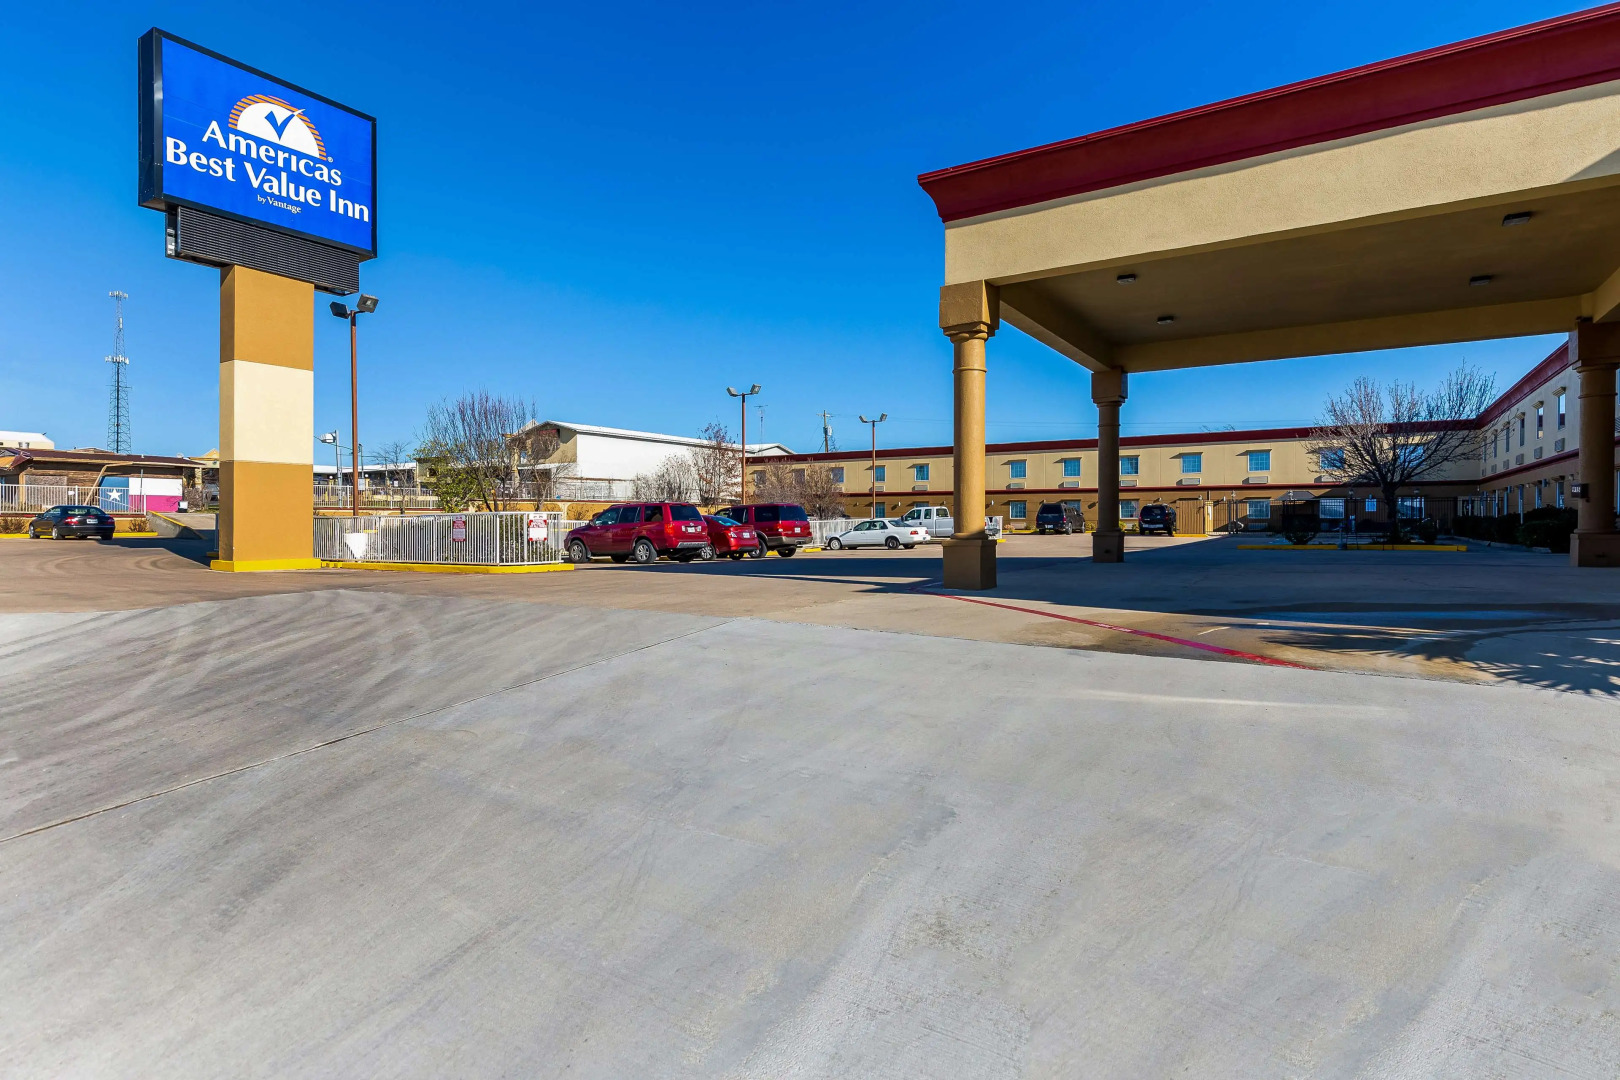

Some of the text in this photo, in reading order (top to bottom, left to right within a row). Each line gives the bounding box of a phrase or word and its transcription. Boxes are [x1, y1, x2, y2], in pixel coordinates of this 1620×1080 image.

[166, 136, 369, 222] Best Value Inn
[202, 120, 342, 186] Americas
[257, 194, 302, 214] by Vantage
